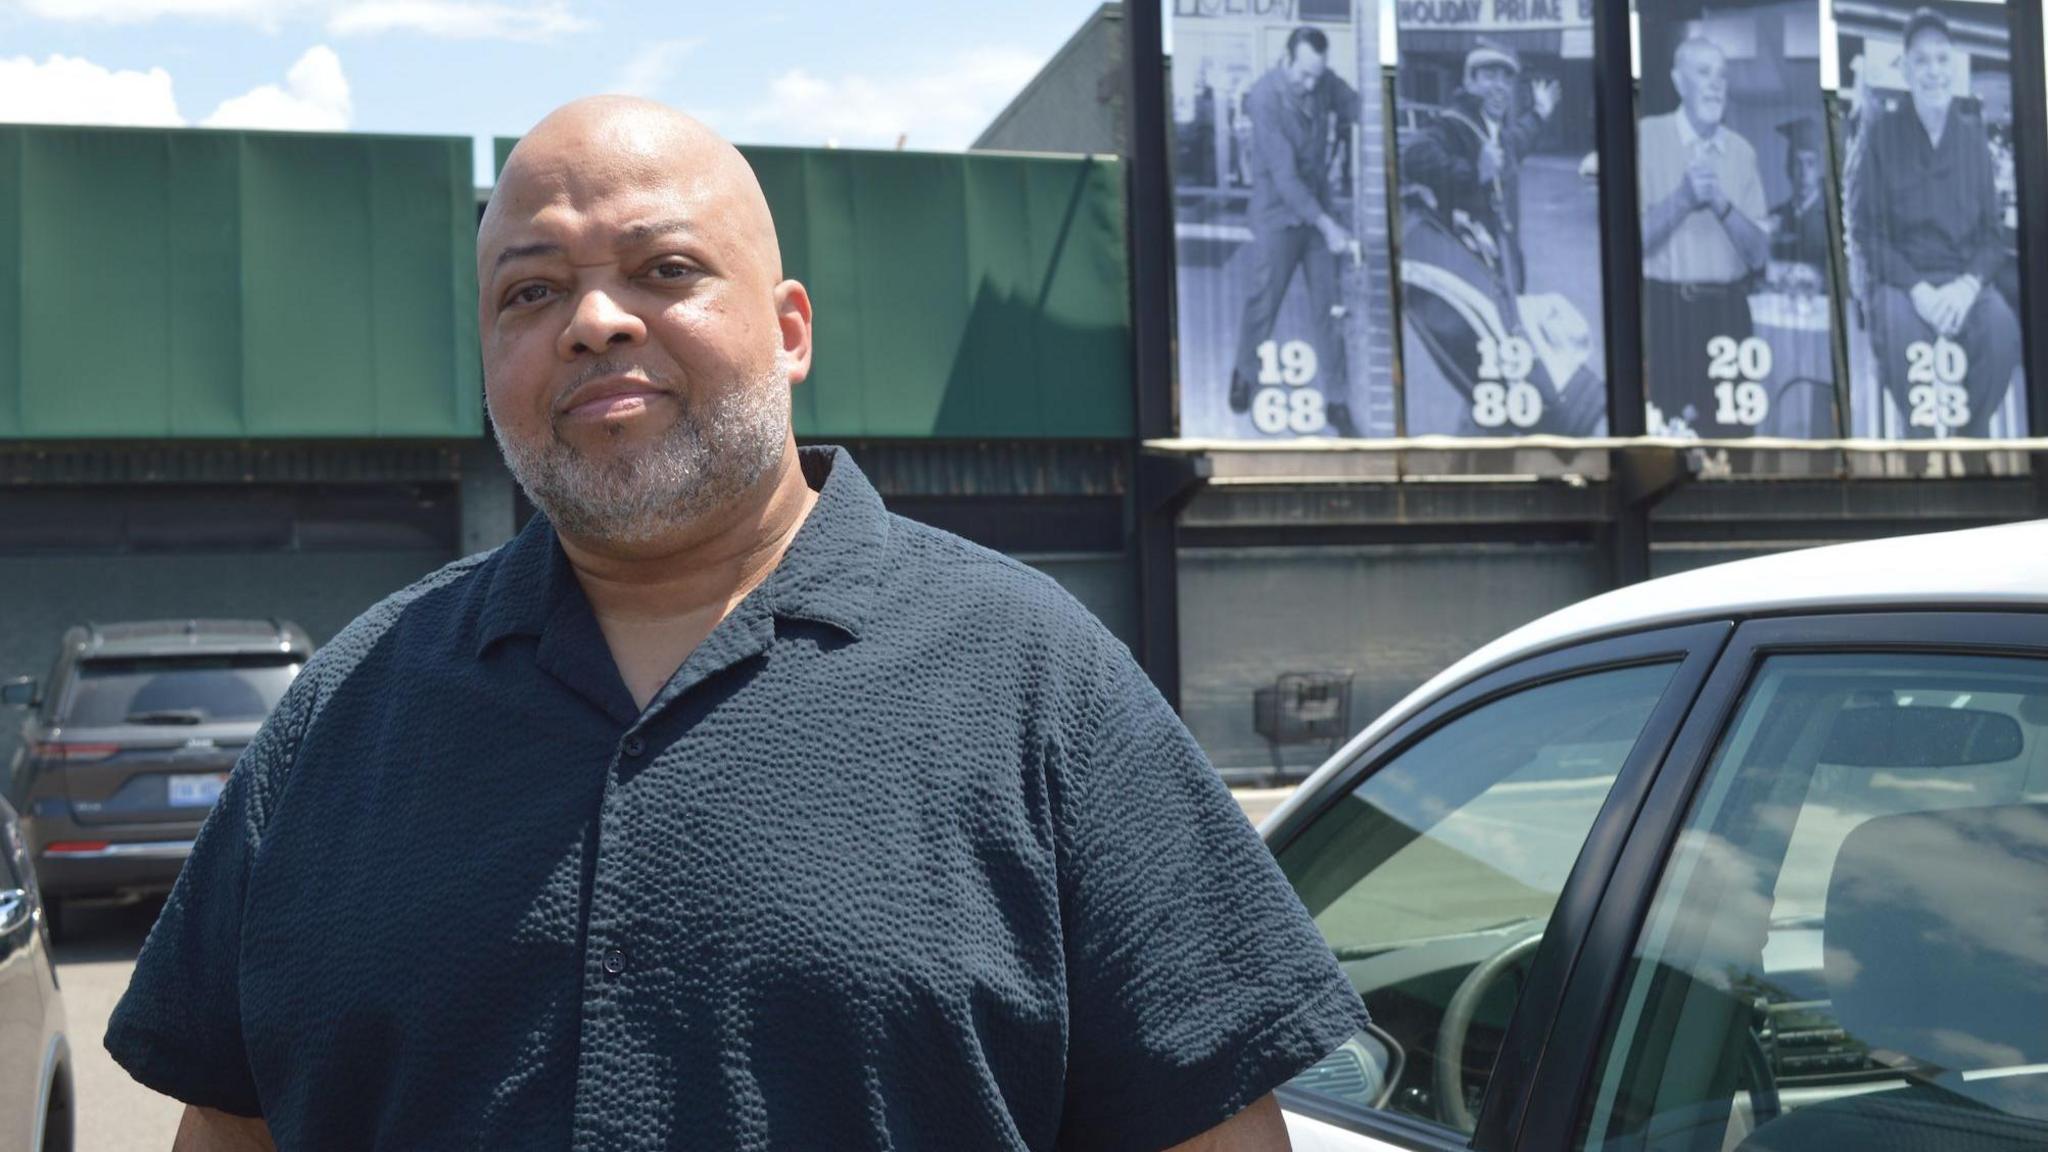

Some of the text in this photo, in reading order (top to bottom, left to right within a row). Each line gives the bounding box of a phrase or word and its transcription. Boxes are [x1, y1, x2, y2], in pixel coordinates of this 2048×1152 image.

[1257, 339, 1318, 387] 19
[1476, 336, 1534, 380] 19
[1706, 335, 1772, 380] 20
[1905, 341, 1968, 384] 20
[1252, 387, 1327, 434] 68
[1472, 381, 1543, 428] 80
[1714, 380, 1769, 426] 19
[1908, 384, 1971, 428] 23
